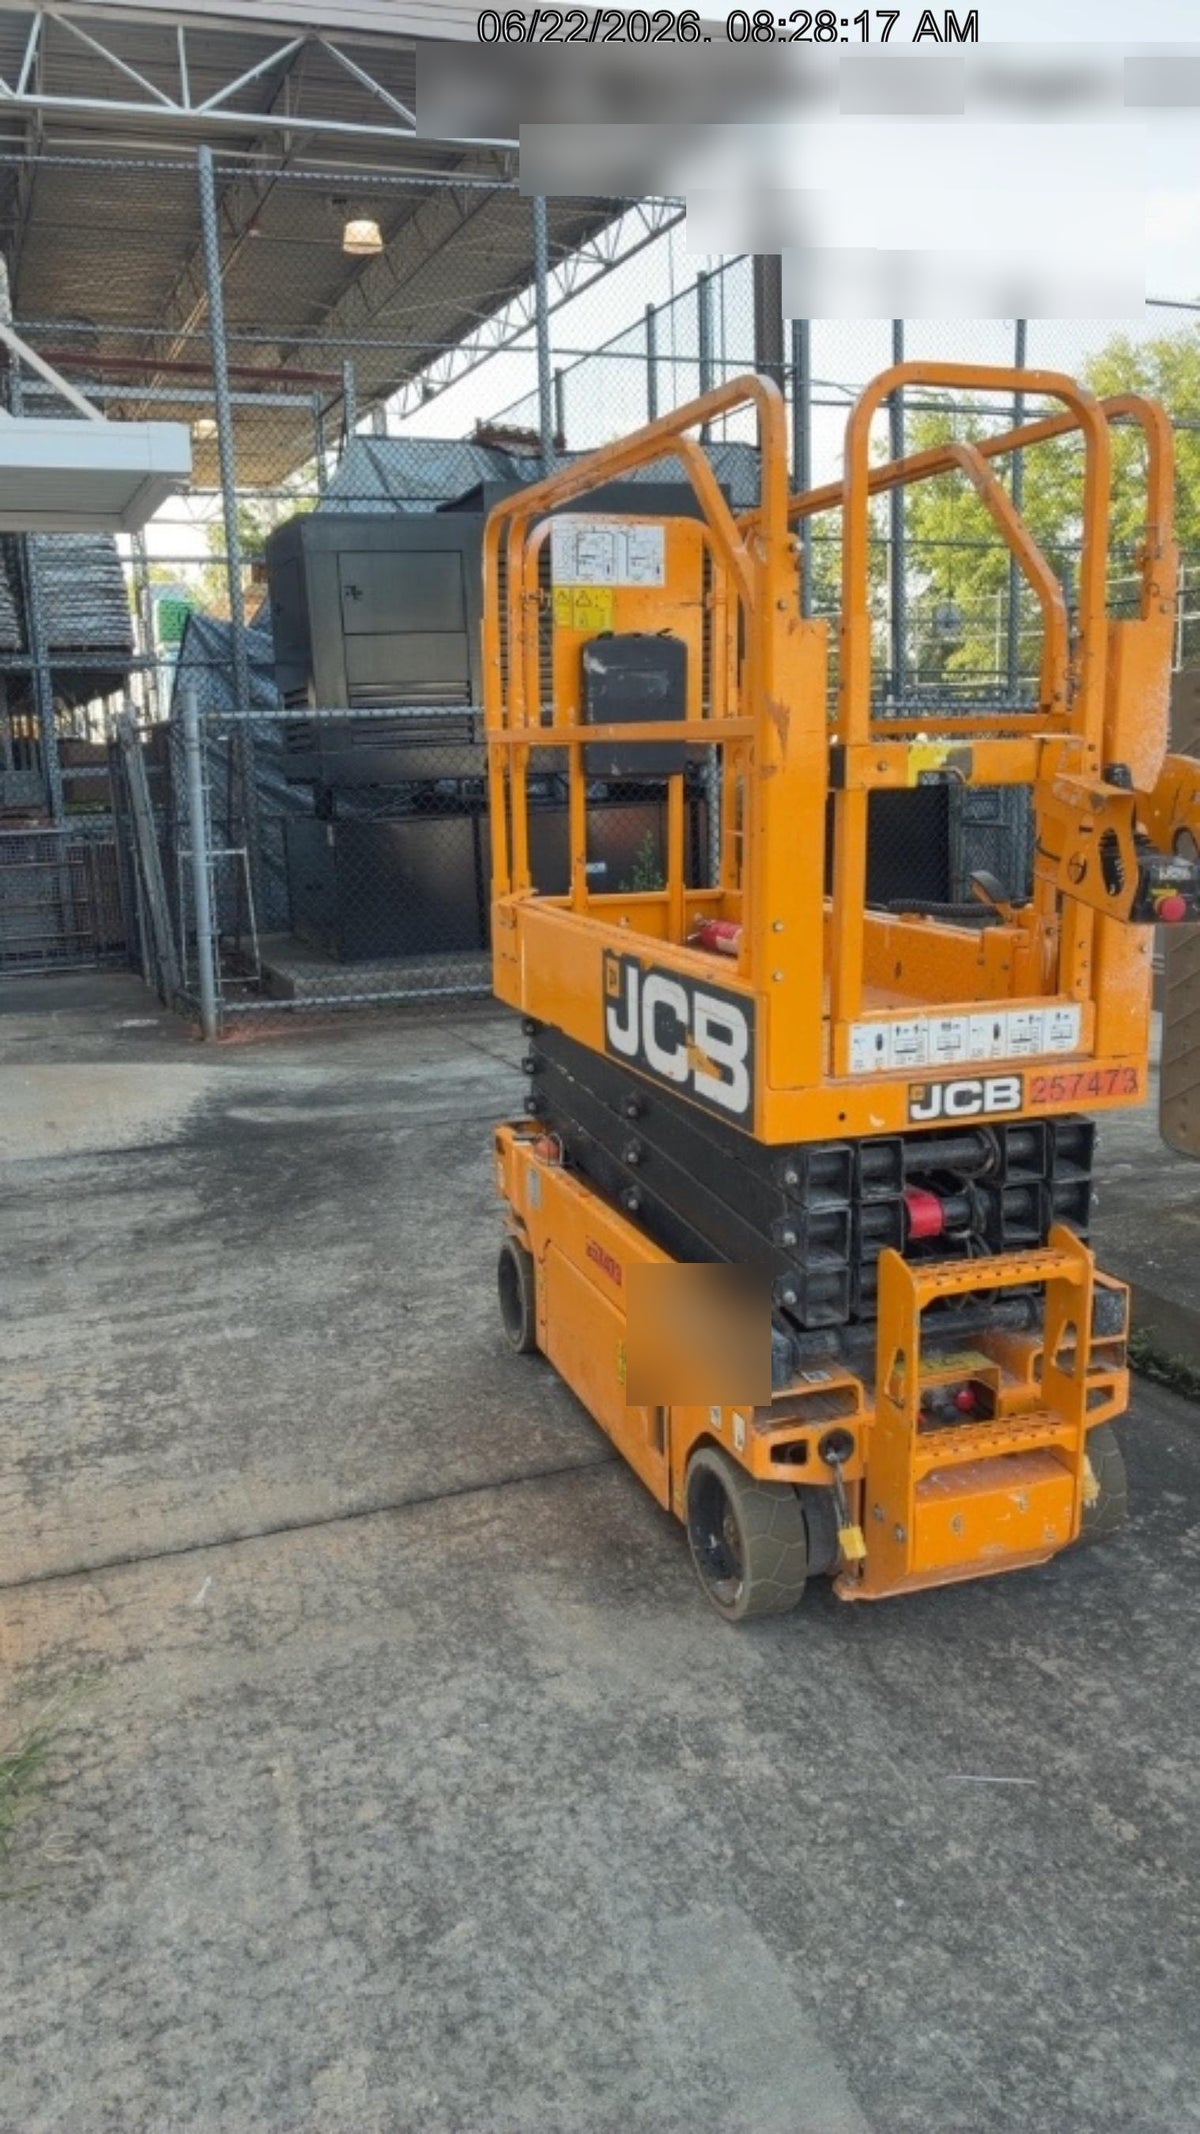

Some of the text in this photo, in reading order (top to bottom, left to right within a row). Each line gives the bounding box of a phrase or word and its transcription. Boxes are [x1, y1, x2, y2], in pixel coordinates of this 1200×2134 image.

[606, 964, 749, 1114] JCB
[910, 1067, 1138, 1120] JCB 257473
